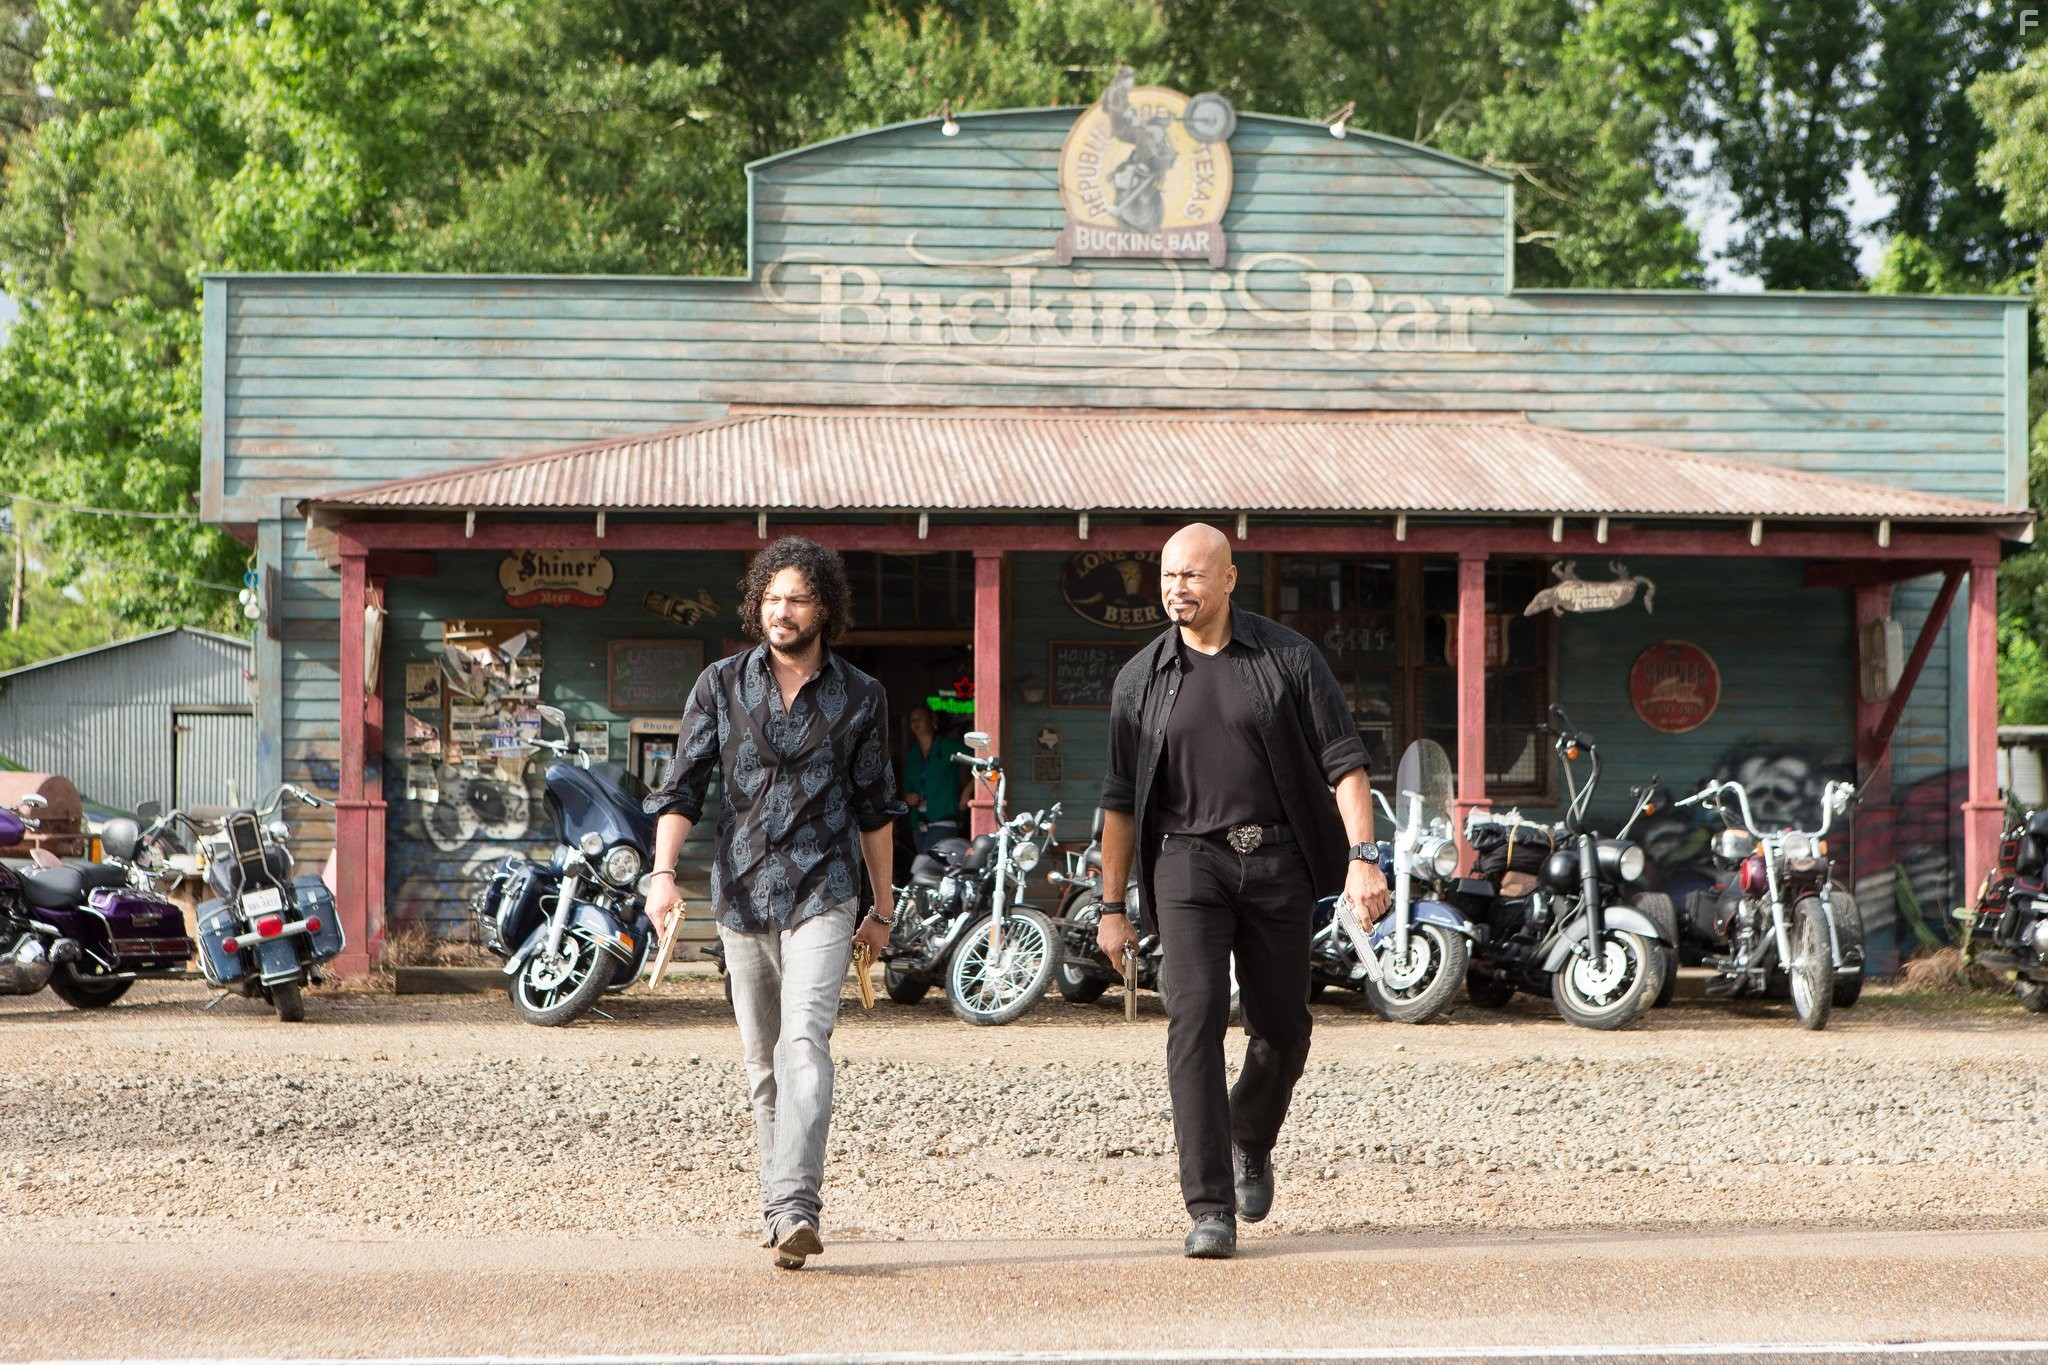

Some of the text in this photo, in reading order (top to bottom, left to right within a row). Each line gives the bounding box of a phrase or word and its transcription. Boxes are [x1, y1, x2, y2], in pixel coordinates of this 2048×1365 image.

[1075, 226, 1211, 251] BUCKING BAR
[810, 263, 1493, 384] Bucking Bar
[517, 550, 597, 581] Shiner
[1104, 605, 1160, 623] BEER
[1058, 648, 1115, 664] HOURS:
[1644, 663, 1707, 685] SHINER
[643, 722, 674, 730] Phone
